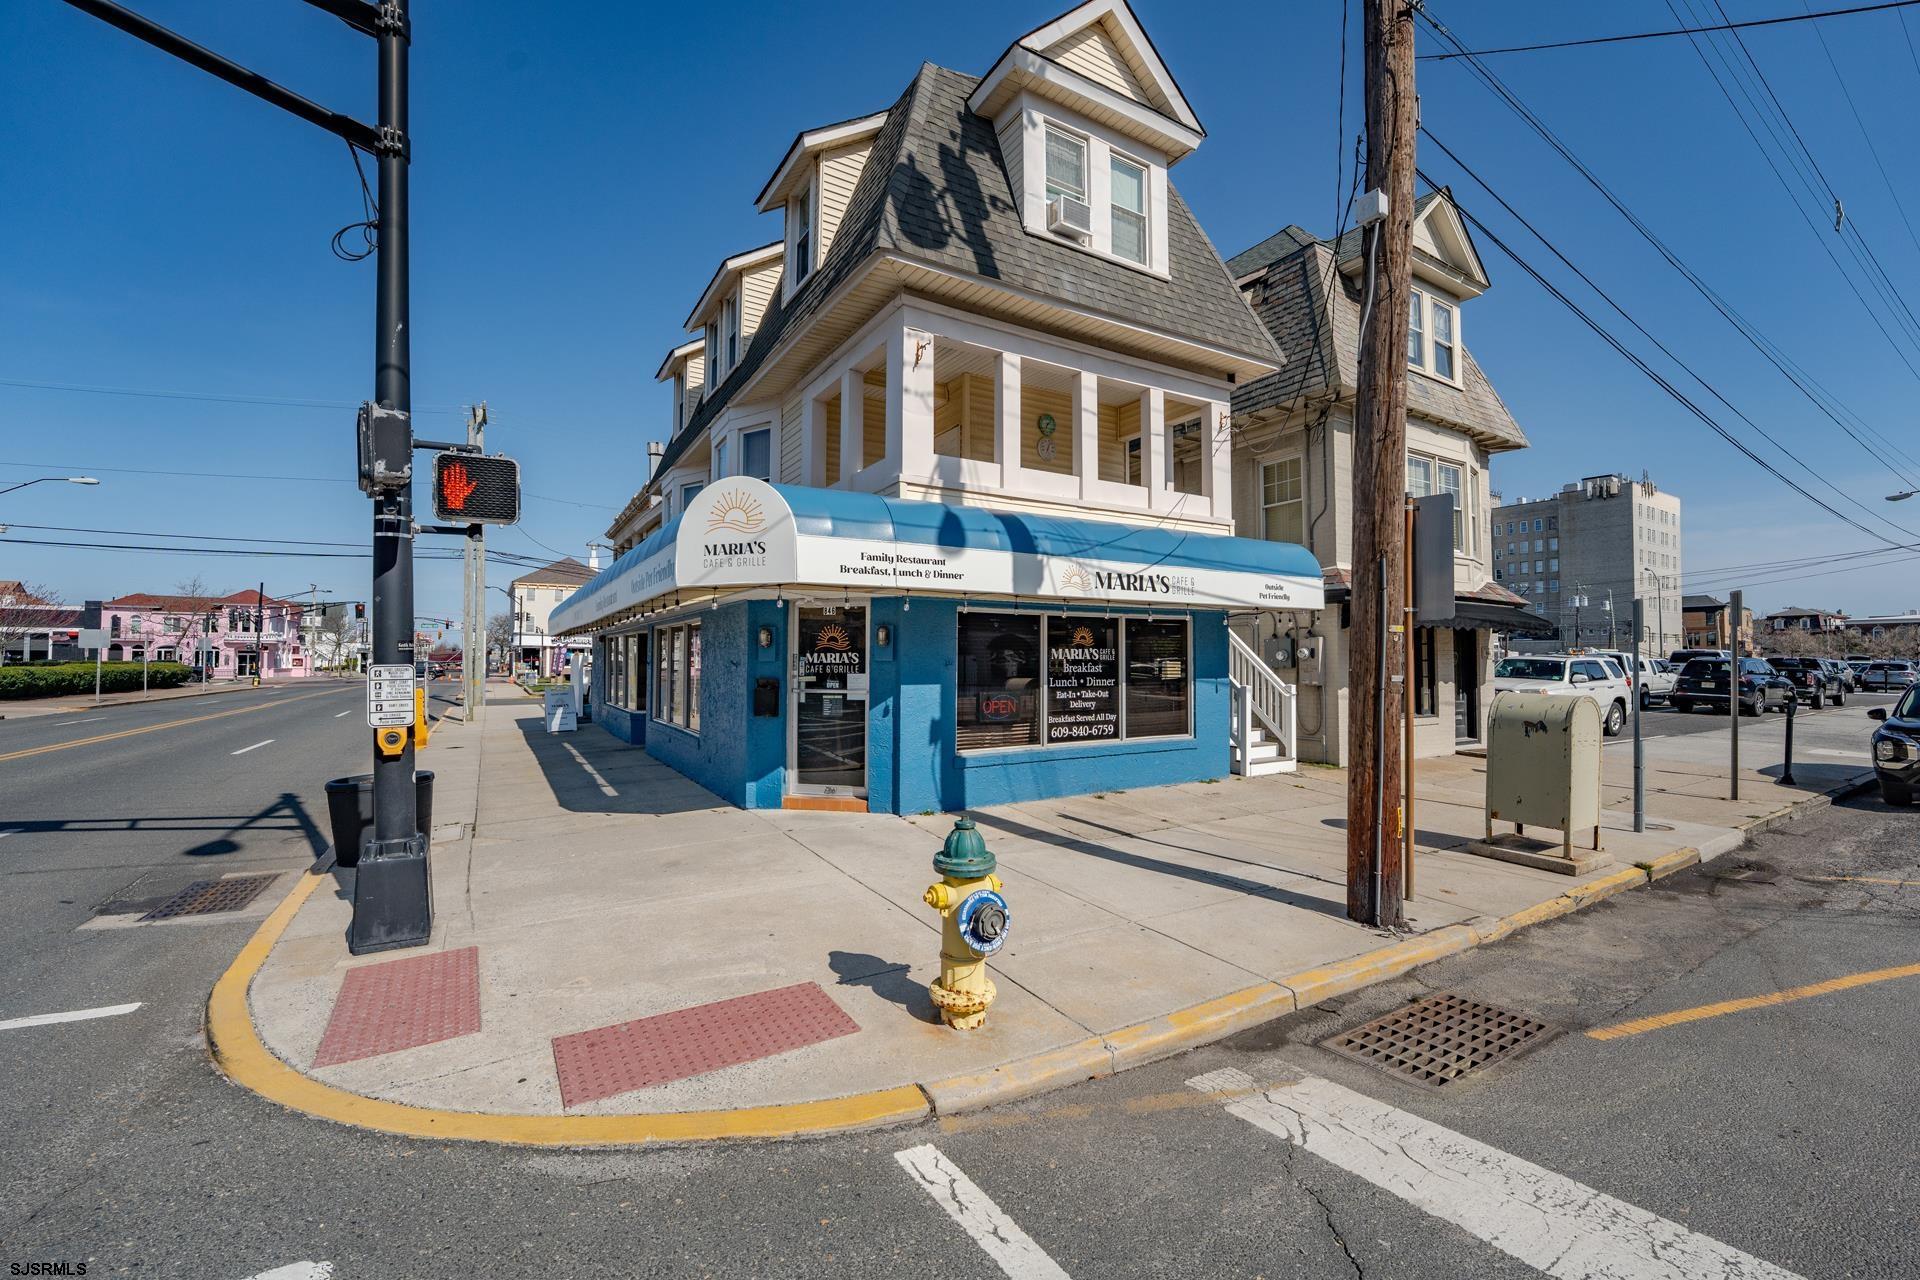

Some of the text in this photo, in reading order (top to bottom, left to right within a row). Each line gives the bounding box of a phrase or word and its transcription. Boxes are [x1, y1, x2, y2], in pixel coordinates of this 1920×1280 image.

[704, 540, 766, 556] MARIA'S
[704, 556, 766, 569] CAFE & GRILLE
[860, 552, 946, 566] Family Restaurant
[840, 564, 965, 580] Breakfast, Lunch & Dinner
[1095, 571, 1170, 594] MARIA'S
[1171, 575, 1188, 586] CAFE
[1171, 585, 1195, 596] GRILLE
[1268, 593, 1290, 602] Friendly
[805, 652, 860, 664] MARIA'S
[1051, 648, 1099, 660] MARIA'S
[805, 665, 823, 674] CAFE
[834, 664, 860, 674] GRILLE
[1063, 662, 1103, 673] Breakfast
[1049, 676, 1116, 687] Lunch Dinner
[1056, 690, 1109, 699] Eat-In Take-Out
[983, 700, 1017, 714] OPEN
[1070, 700, 1096, 710] Delivery
[1049, 713, 1117, 724] Breakfast Served All Day
[1051, 724, 1114, 738] 609-840-6759
